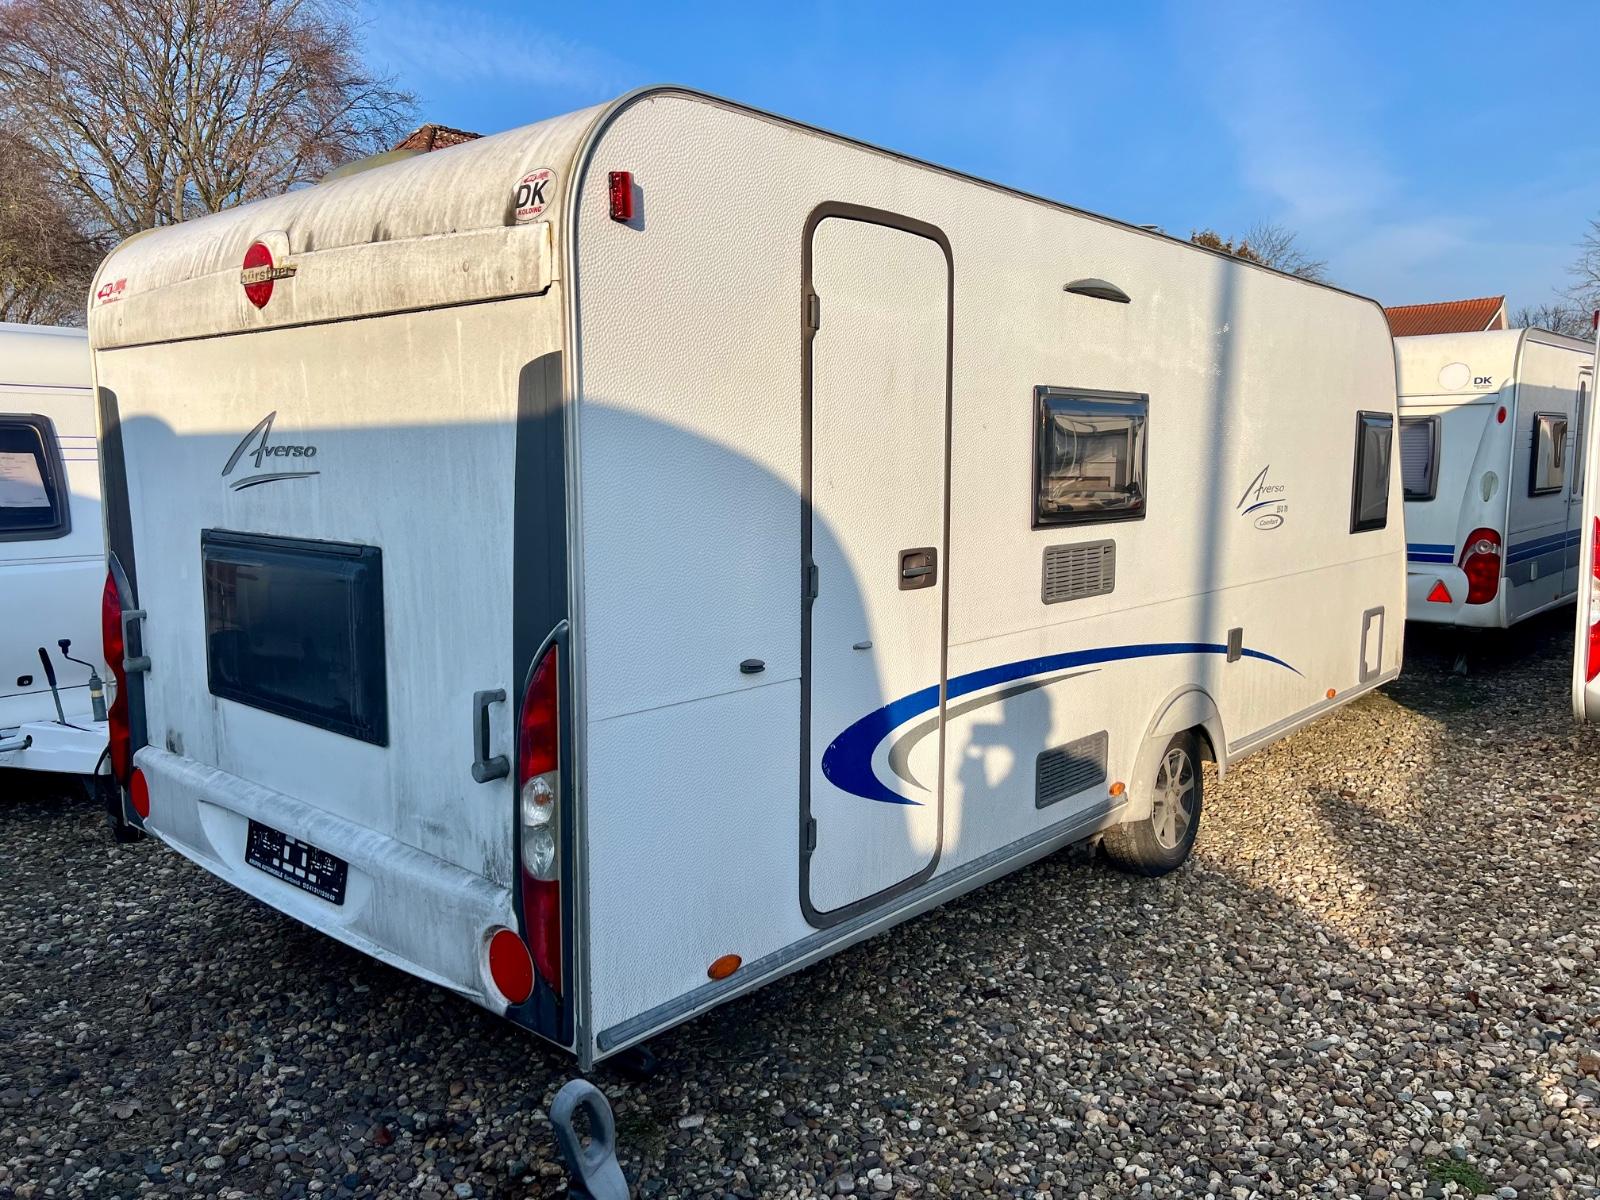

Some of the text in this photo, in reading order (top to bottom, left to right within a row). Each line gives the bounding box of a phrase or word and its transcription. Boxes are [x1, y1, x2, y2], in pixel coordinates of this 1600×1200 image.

[515, 179, 549, 208] DK
[517, 206, 542, 216] KOLDING
[240, 266, 289, 284] bürstner
[1473, 376, 1492, 384] DK
[221, 410, 317, 477] Averso
[1236, 464, 1284, 509] Averso
